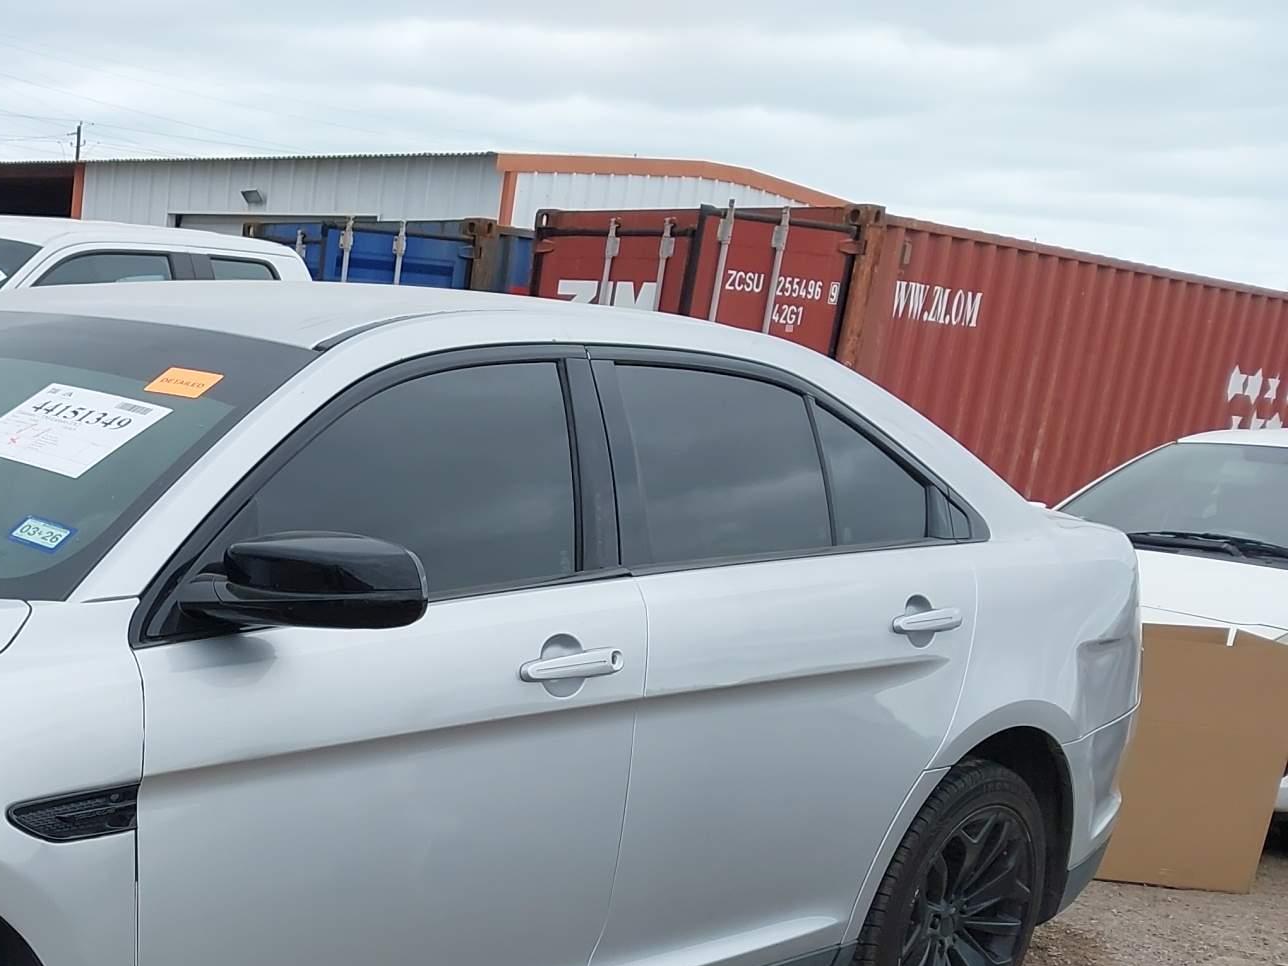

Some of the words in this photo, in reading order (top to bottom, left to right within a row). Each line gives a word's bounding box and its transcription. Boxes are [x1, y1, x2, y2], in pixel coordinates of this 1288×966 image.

[557, 279, 659, 311] ZM
[725, 269, 765, 293] ZCSU
[775, 276, 824, 301] 255496
[829, 282, 840, 304] 9
[772, 303, 804, 326] 42G1
[32, 400, 132, 431] 44151349
